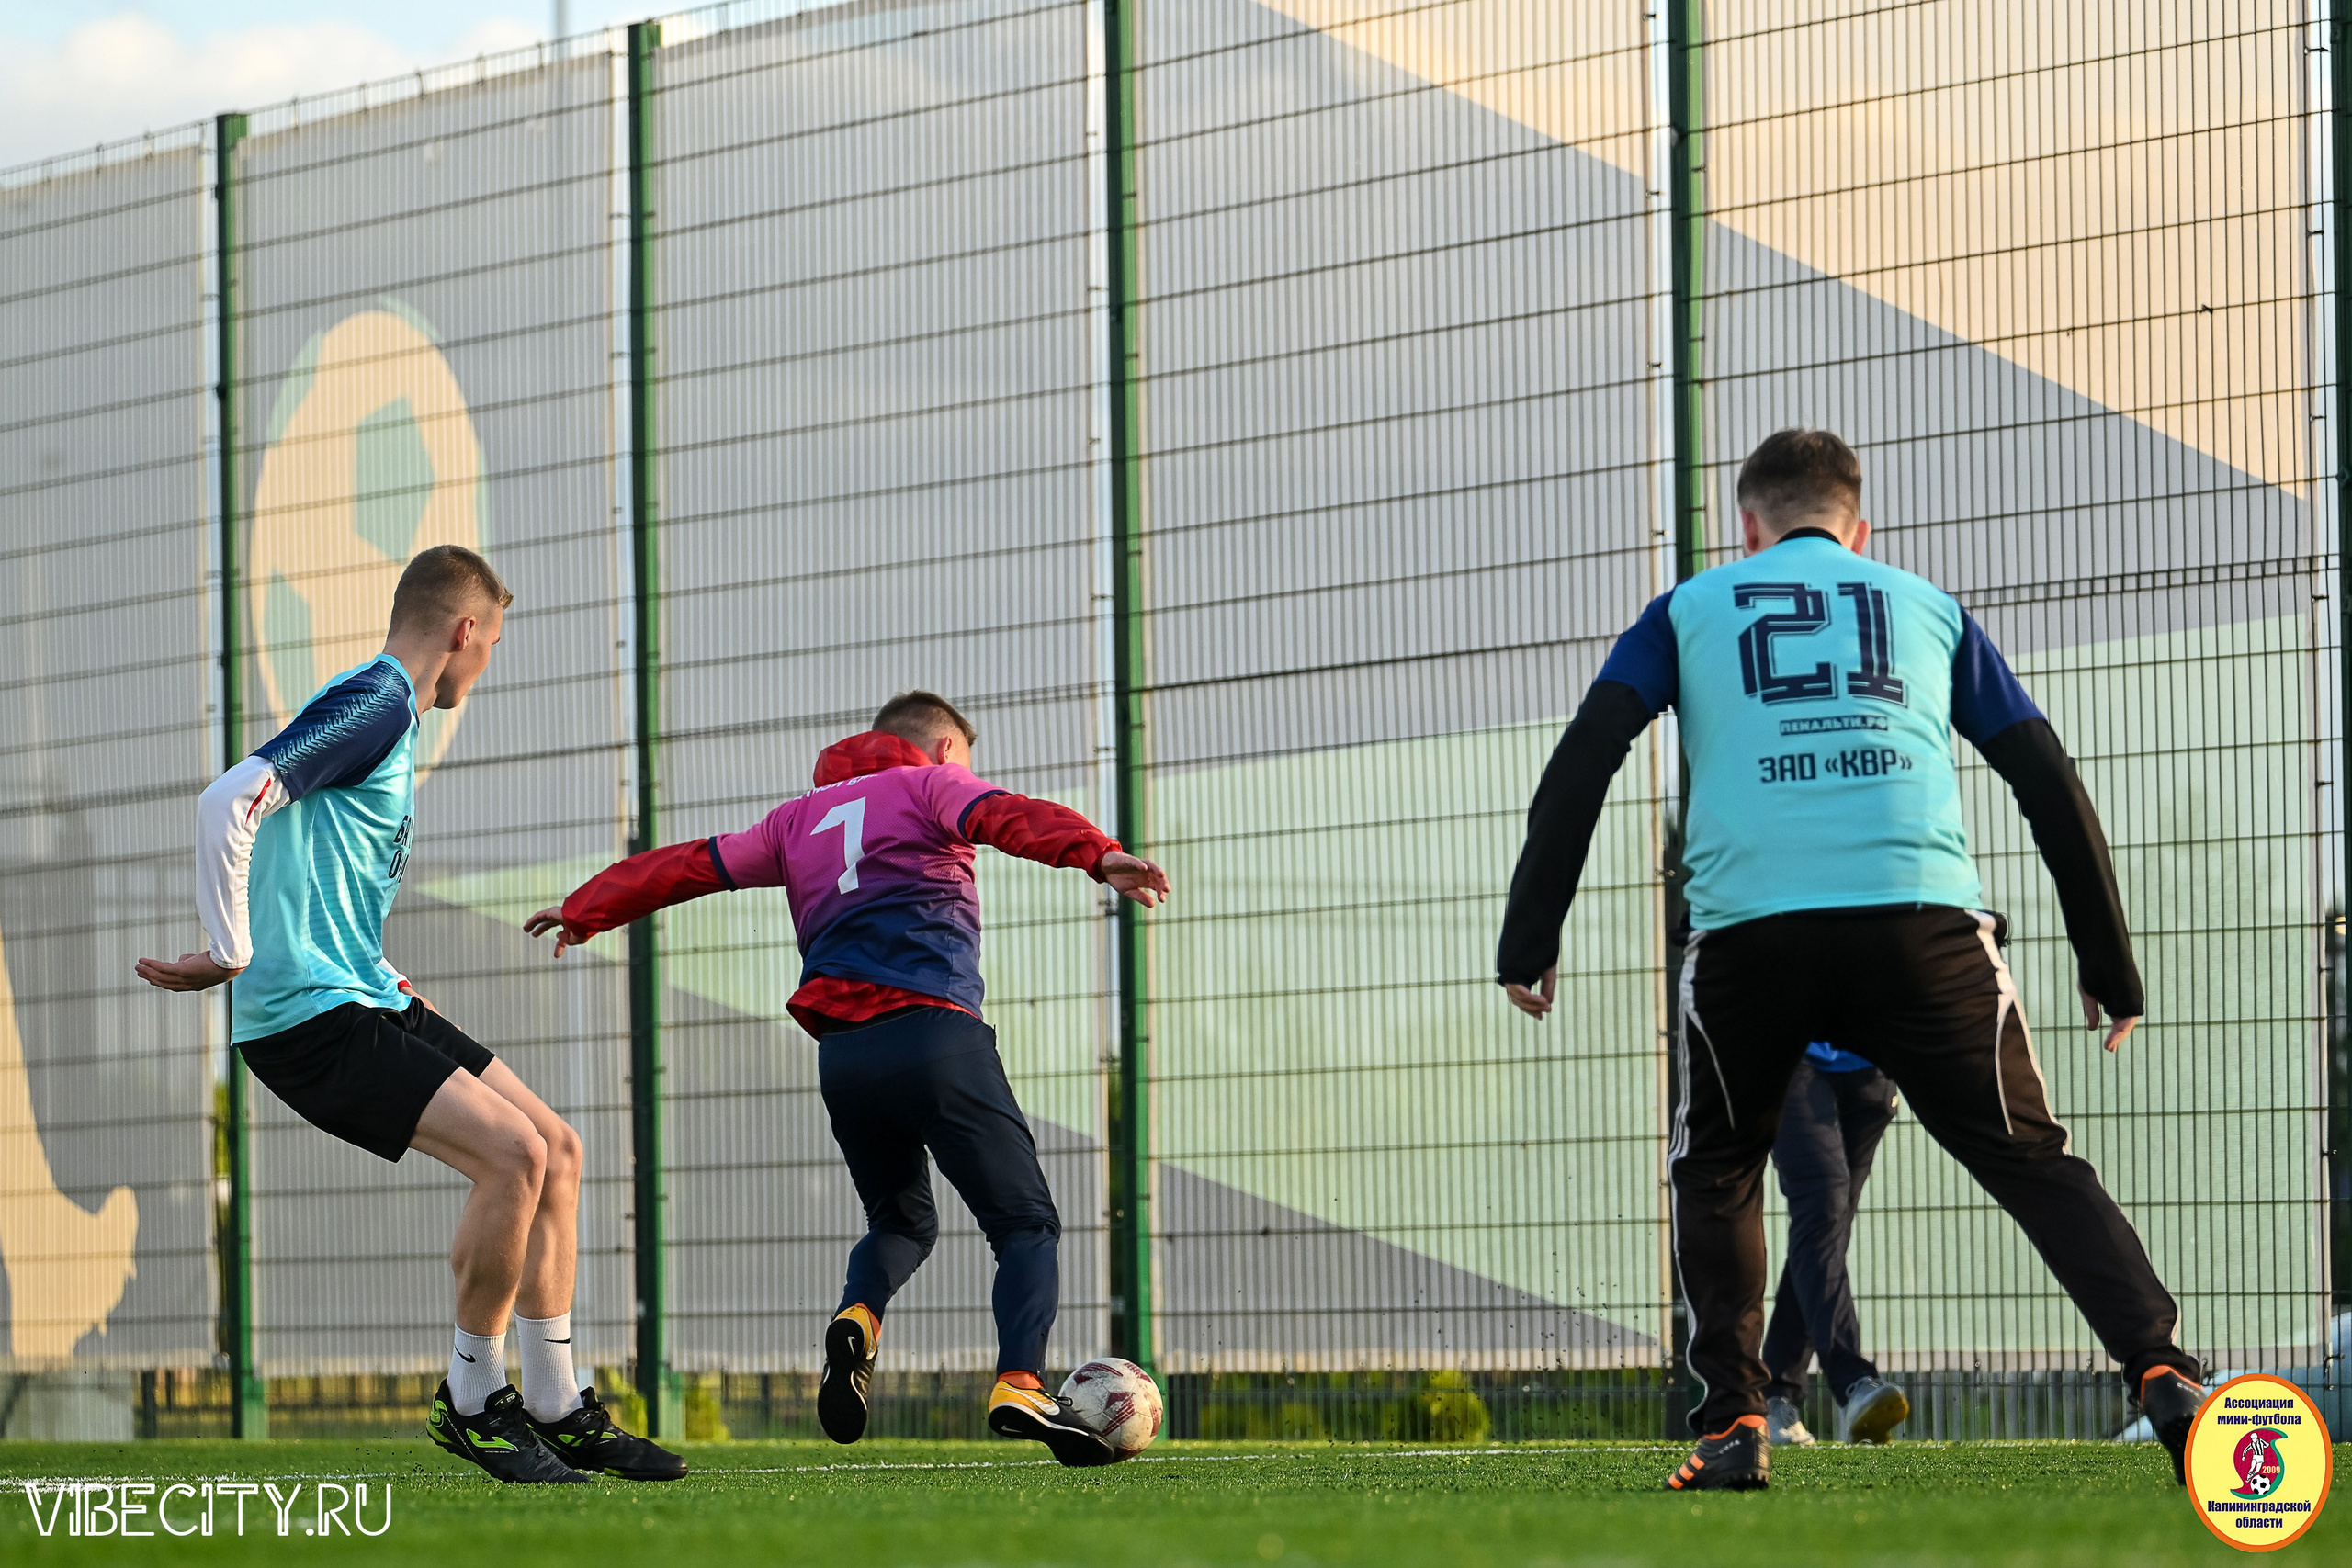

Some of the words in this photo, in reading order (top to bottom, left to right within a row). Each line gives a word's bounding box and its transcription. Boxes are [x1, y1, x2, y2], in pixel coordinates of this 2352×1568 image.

[1733, 582, 1908, 709] 21
[1758, 752, 1816, 784] ЗАО
[1825, 749, 1913, 779] «КВР»
